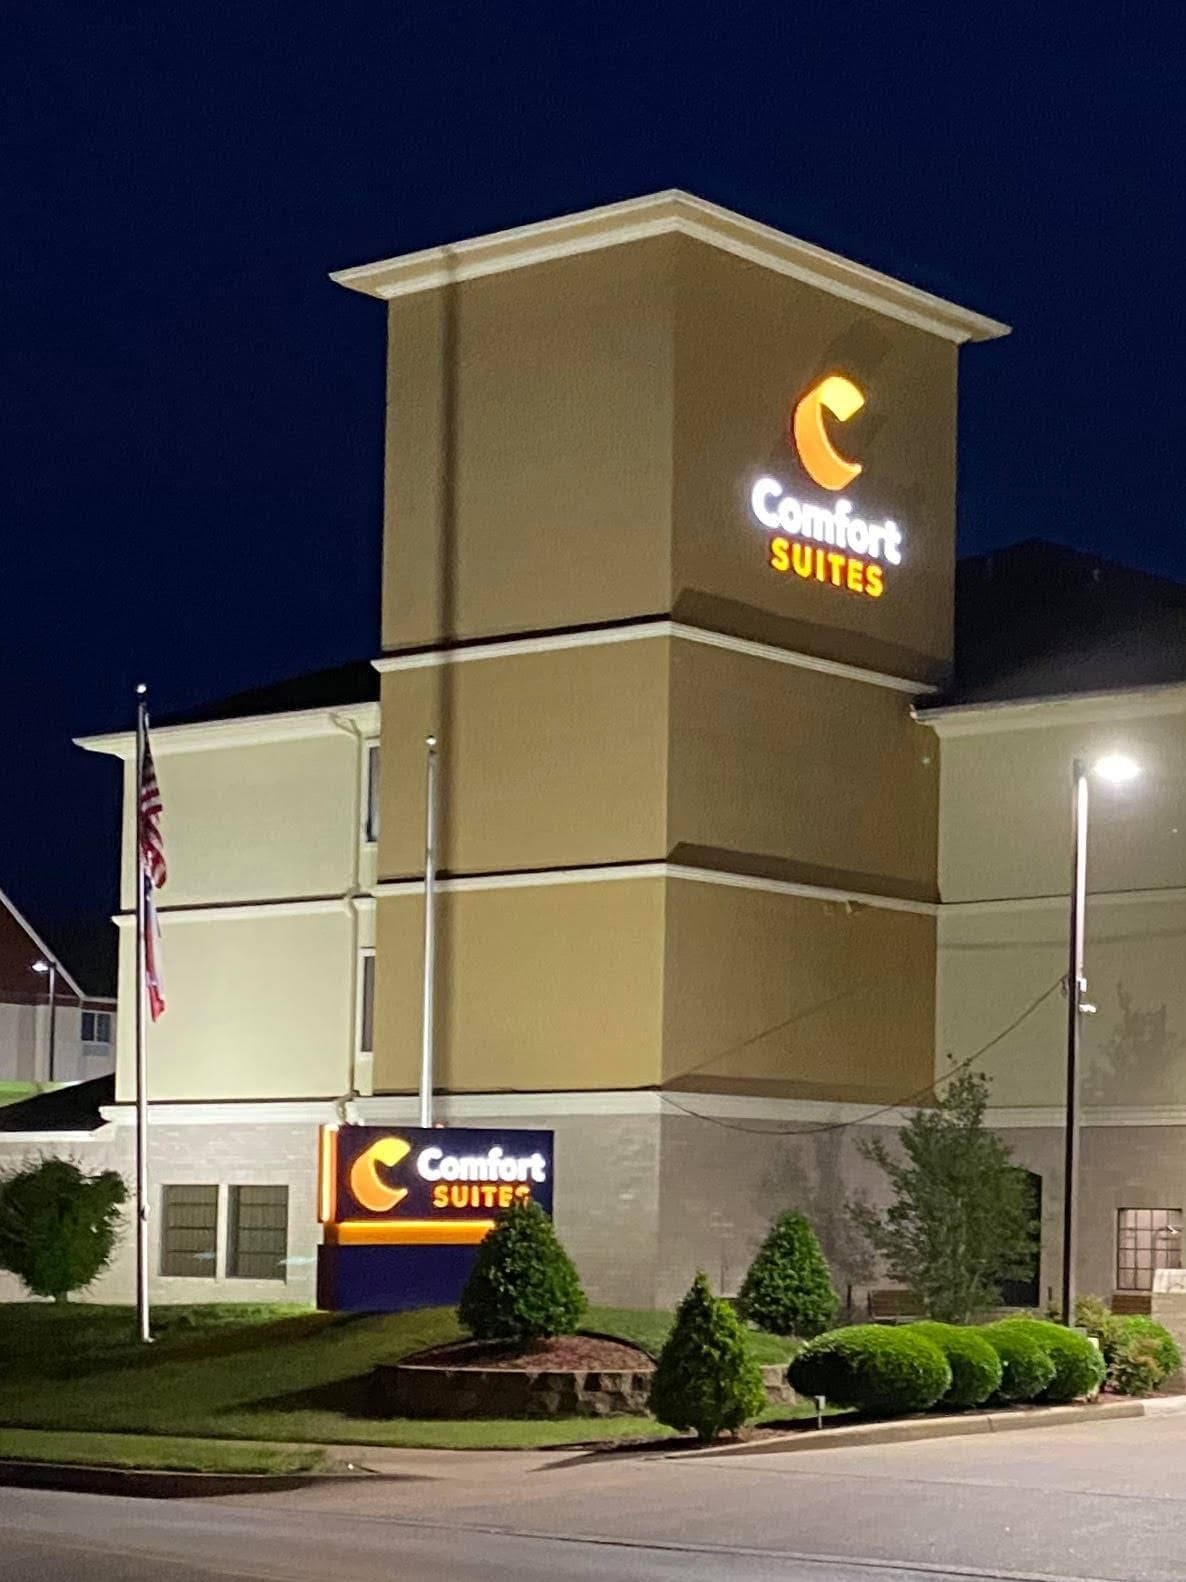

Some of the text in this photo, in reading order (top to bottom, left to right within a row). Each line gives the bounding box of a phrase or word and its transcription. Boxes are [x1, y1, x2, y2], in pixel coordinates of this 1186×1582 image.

[751, 478, 902, 566] Comfort
[770, 536, 884, 597] SUITES
[416, 1147, 547, 1182] Comfort
